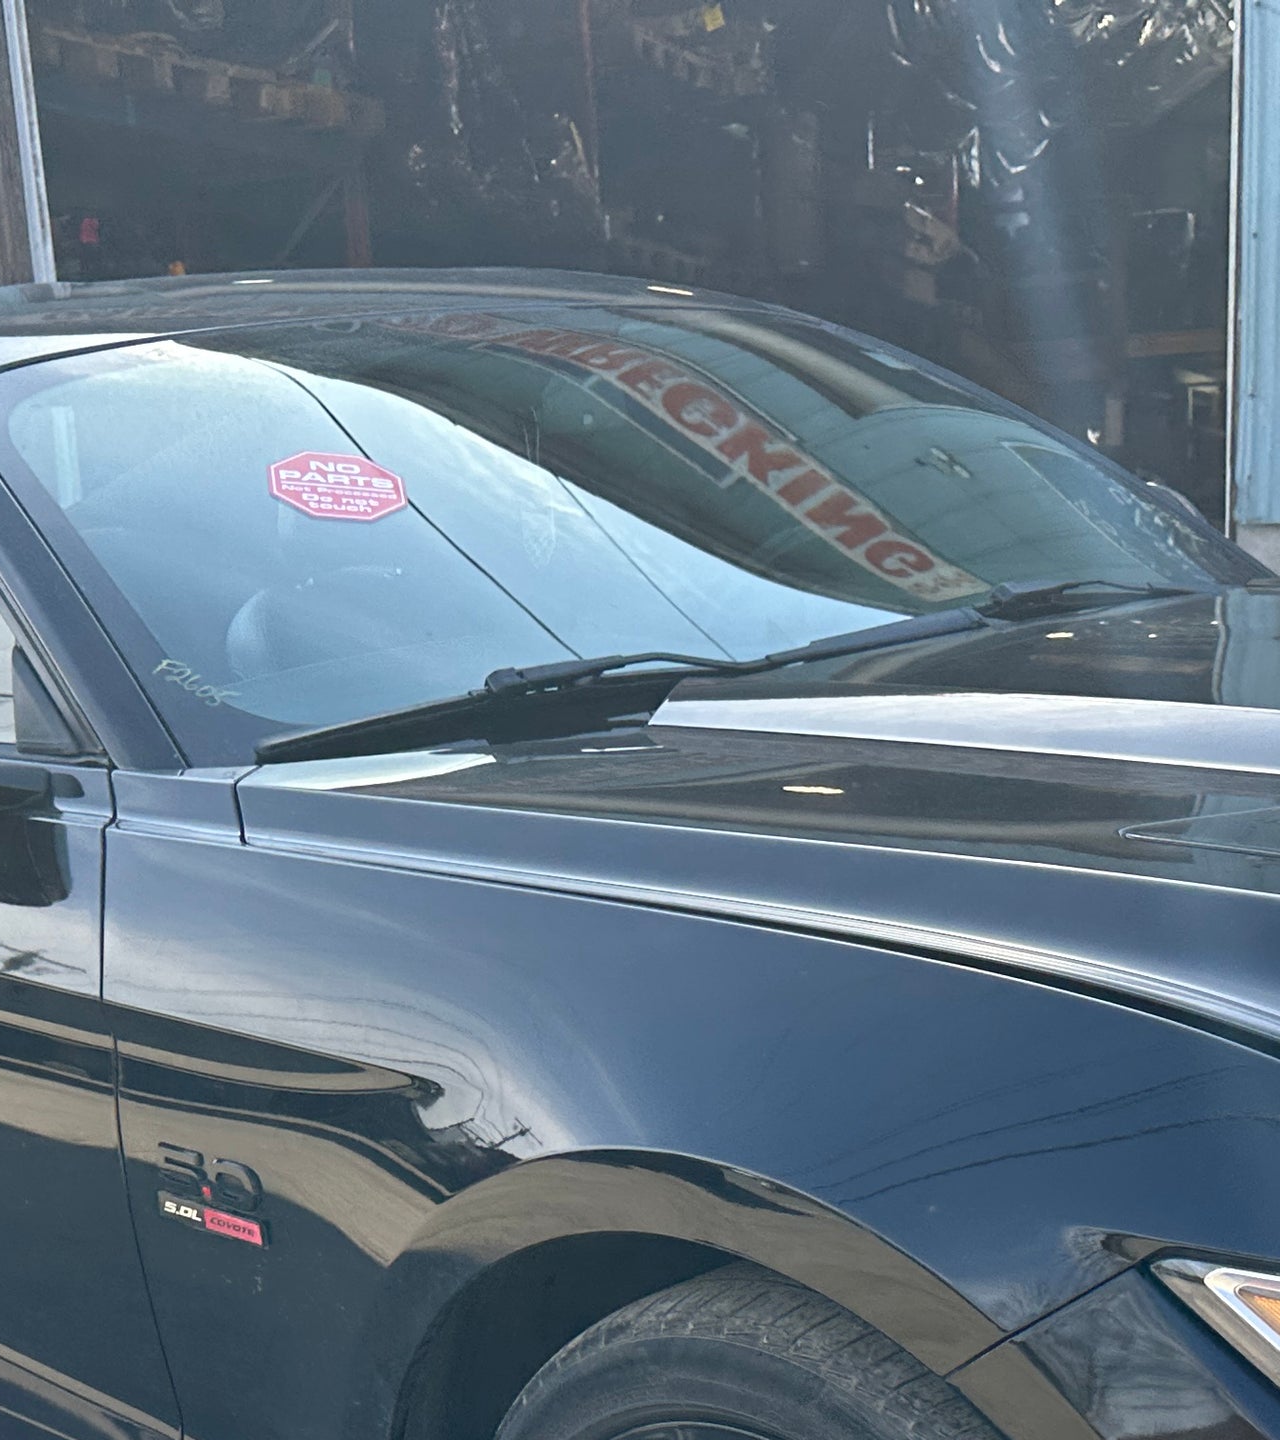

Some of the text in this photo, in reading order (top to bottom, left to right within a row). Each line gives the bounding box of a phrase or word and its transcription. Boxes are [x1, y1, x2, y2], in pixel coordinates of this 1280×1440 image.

[309, 460, 361, 475] NO
[278, 469, 395, 489] PARTS
[301, 492, 380, 507] Do not
[308, 501, 373, 513] touch
[209, 1216, 256, 1238] COYOTE
